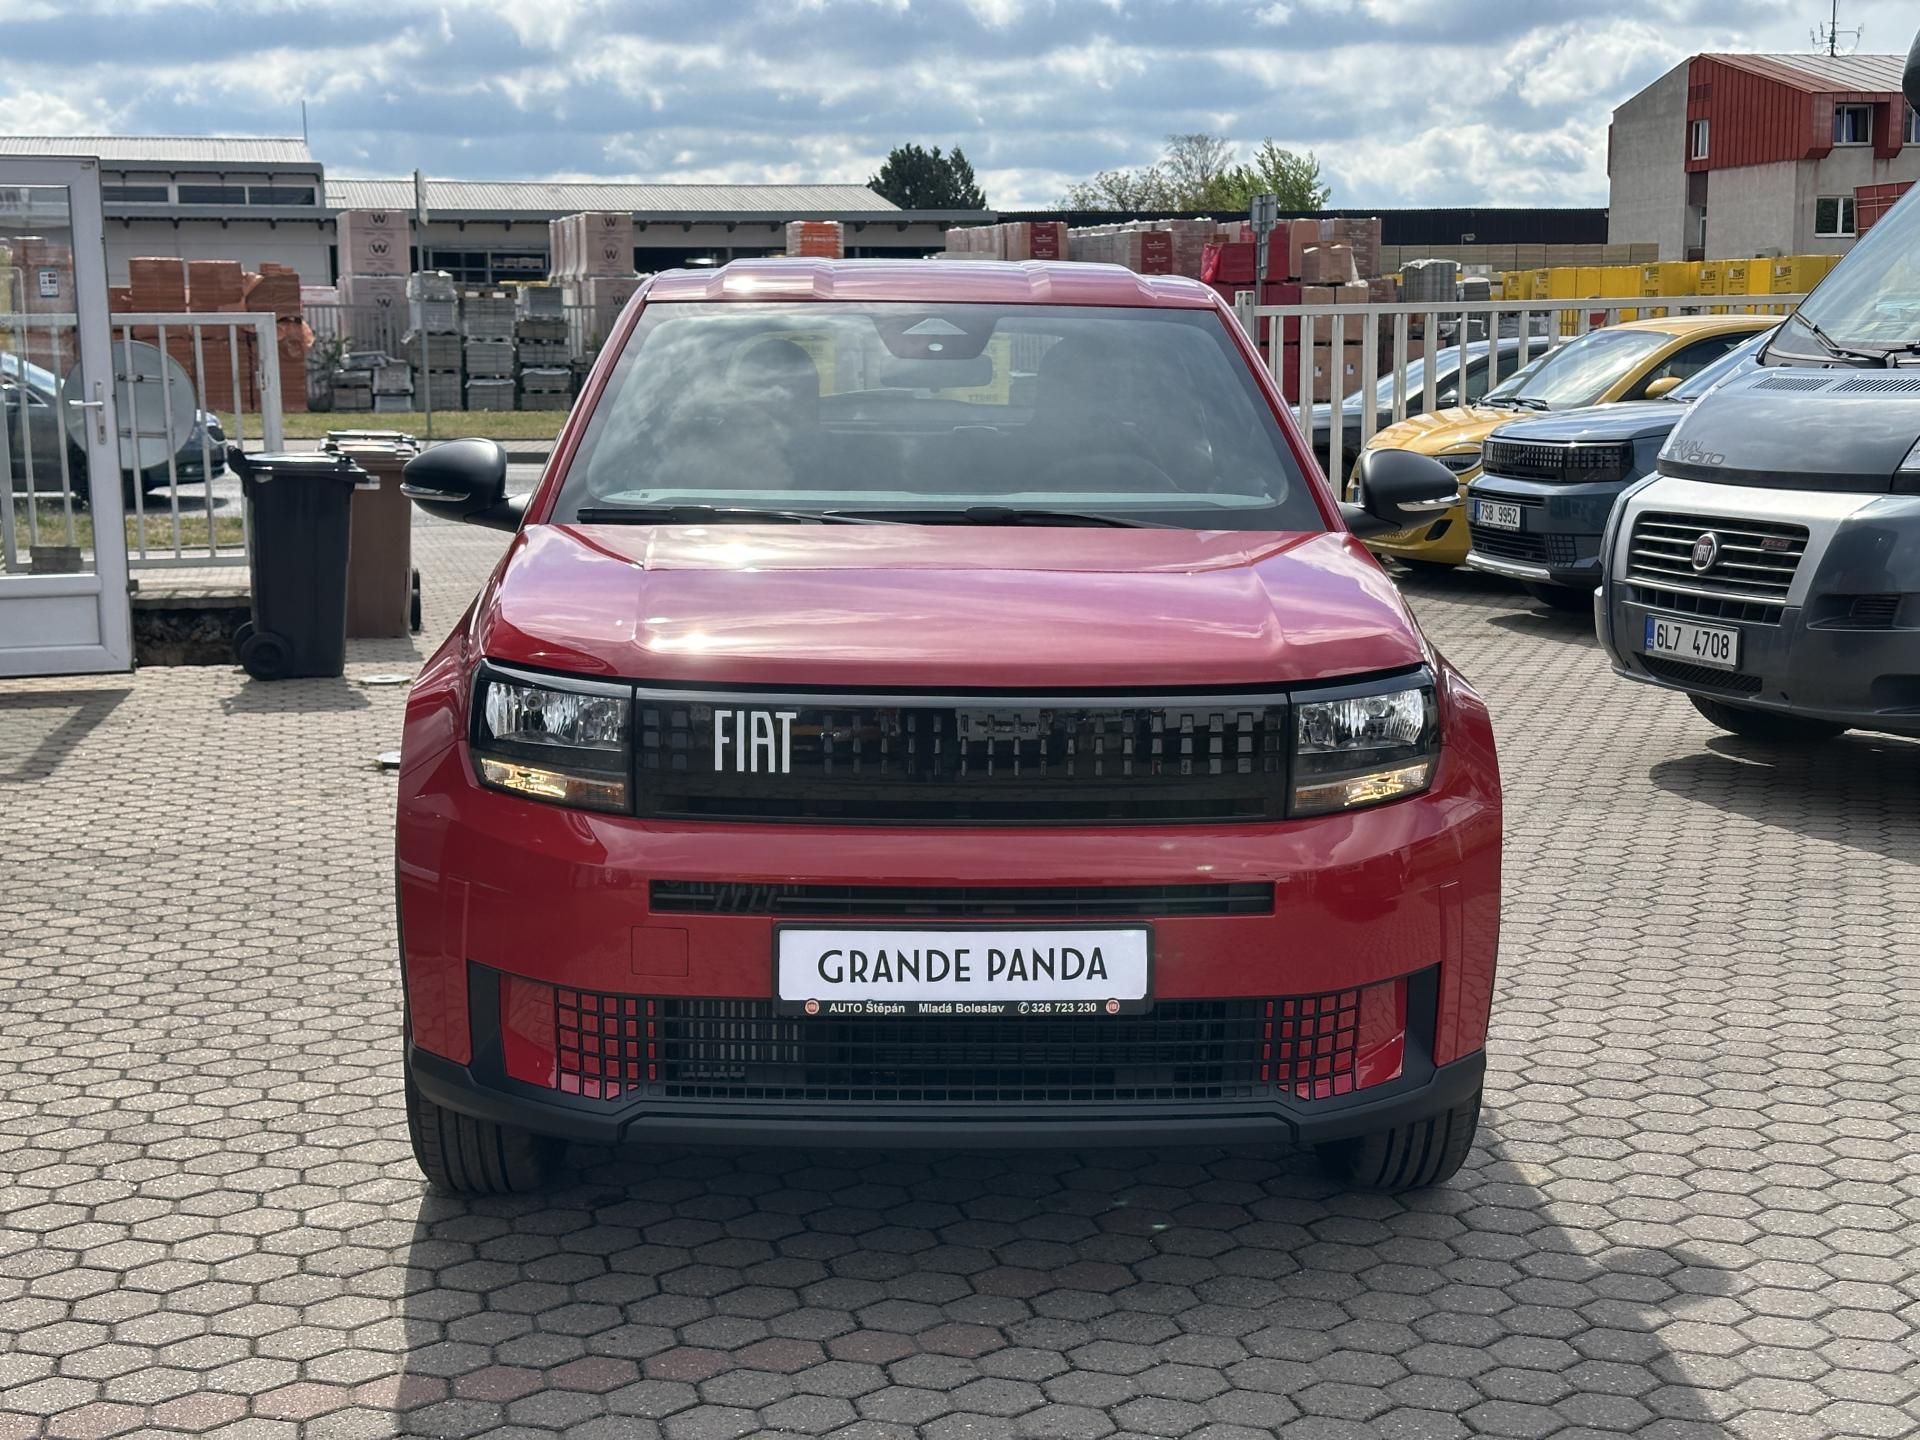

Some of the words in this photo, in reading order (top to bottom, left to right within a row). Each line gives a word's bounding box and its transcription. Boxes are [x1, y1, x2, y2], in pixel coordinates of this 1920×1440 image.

[371, 244, 388, 254] W
[604, 249, 618, 260] W
[1498, 506, 1517, 525] 9952
[1656, 623, 1682, 651] 6L7
[1692, 629, 1730, 659] 4708
[714, 709, 798, 774] FIAT
[817, 948, 971, 984] GRANDE
[987, 946, 1109, 983] PANDA
[829, 1002, 863, 1013] AUTO
[865, 1000, 906, 1015] Štěpán
[918, 1002, 952, 1013] Mladá
[955, 1002, 1005, 1013] Boleslav
[1031, 1002, 1051, 1013] 326
[1055, 1002, 1075, 1013] 723
[1077, 1002, 1097, 1013] 230
